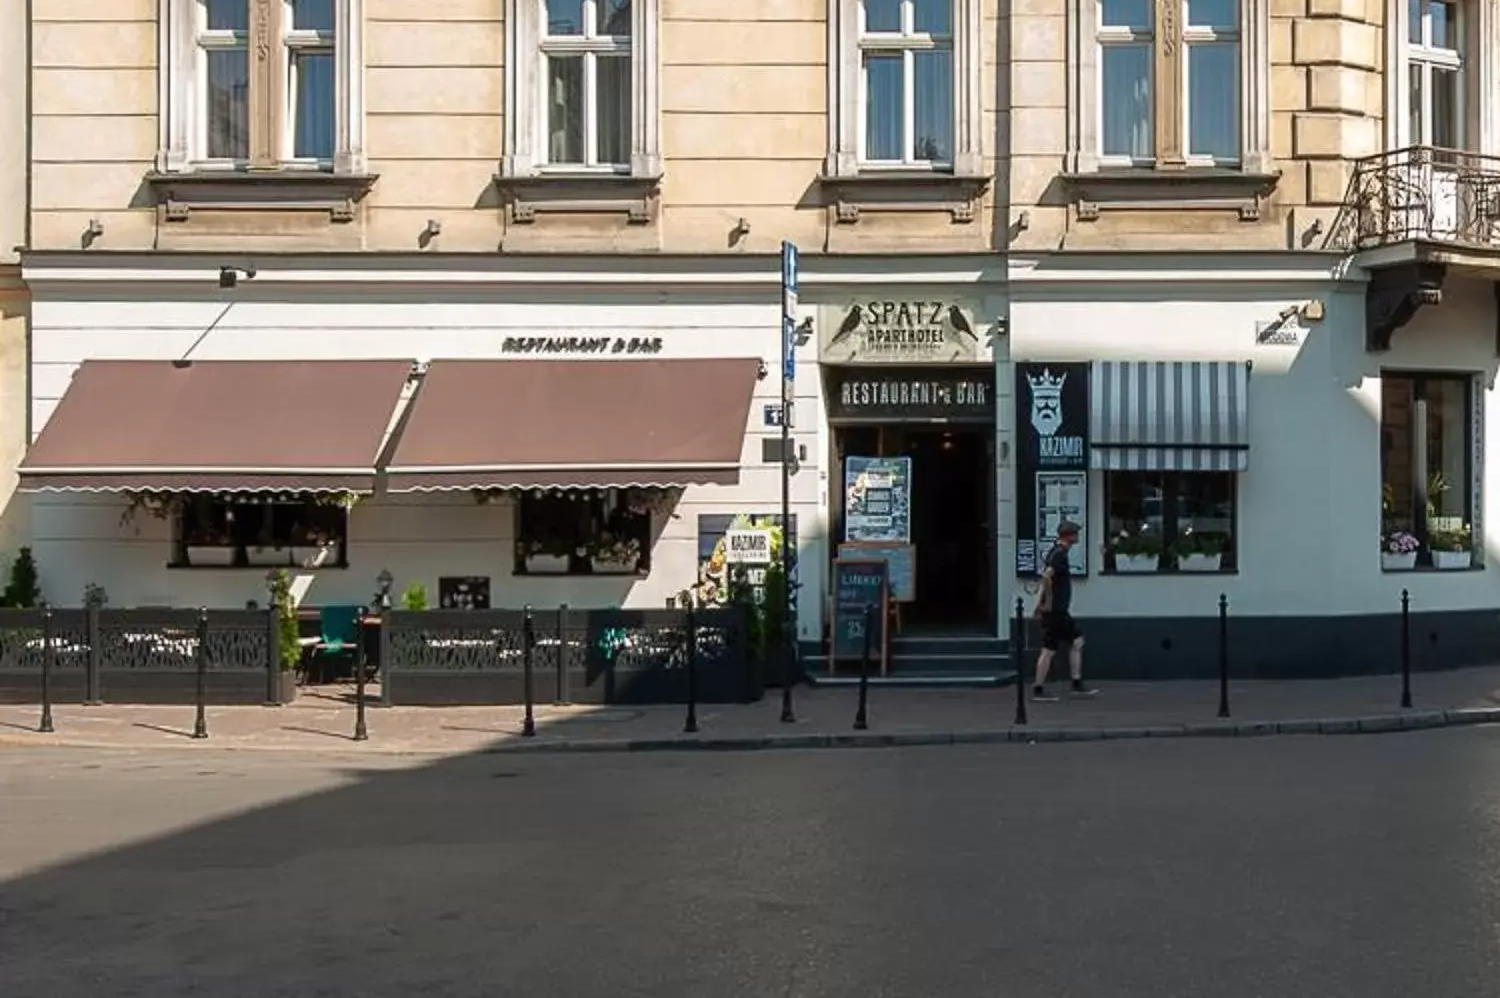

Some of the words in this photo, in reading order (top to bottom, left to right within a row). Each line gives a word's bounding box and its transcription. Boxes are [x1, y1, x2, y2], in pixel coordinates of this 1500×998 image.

[867, 302, 945, 326] SPATZ
[502, 337, 611, 353] RESTAURANT
[627, 337, 663, 353] BAR
[868, 329, 945, 343] APARTHOTEL
[842, 381, 940, 405] RESTAURANT
[956, 381, 985, 404] BAR
